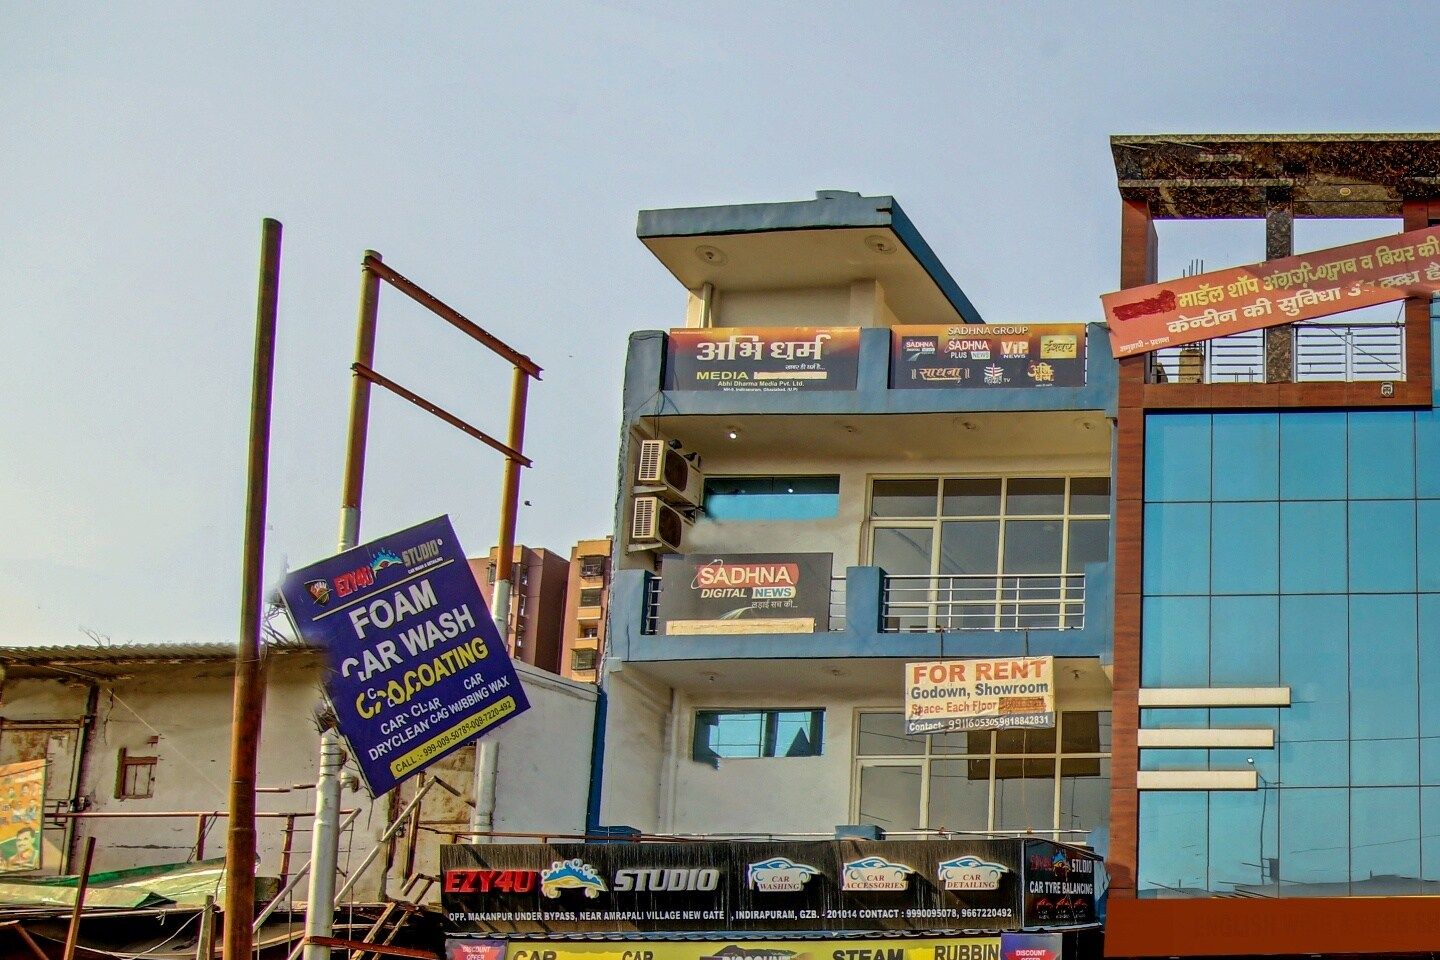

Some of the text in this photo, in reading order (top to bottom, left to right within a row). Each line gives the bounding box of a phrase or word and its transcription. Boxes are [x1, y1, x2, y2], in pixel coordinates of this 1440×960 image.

[1375, 245, 1415, 268] बियर
[1417, 235, 1440, 258] की
[1241, 298, 1273, 318] की
[948, 326, 1029, 336] SADHNA GROUP
[696, 334, 832, 361] अभि धर्म
[948, 341, 990, 351] SADHNA
[950, 351, 967, 359] PLUS
[972, 351, 990, 360] NEWS
[696, 371, 749, 380] MEDIA
[401, 539, 439, 568] STUDIO
[700, 566, 794, 586] SADHNA
[701, 588, 792, 599] DIGITAL NEWS
[349, 579, 438, 640] FOAM
[771, 600, 782, 608] सच
[399, 603, 476, 657] WASH
[913, 660, 1047, 685] FOR RENT
[463, 672, 485, 691] CAR
[488, 675, 510, 695] WAX
[911, 682, 1048, 700] Godown, Showroom
[946, 701, 970, 713] Each
[972, 700, 997, 714] Floor
[395, 755, 418, 773] CALL
[444, 868, 720, 894] EZY4U STUDIO
[771, 875, 790, 883] CAR
[867, 874, 885, 882] CAR
[947, 881, 995, 889] DETAILING
[759, 883, 800, 891] WASHING
[1029, 880, 1093, 895] CAR TYRE BALANCING
[449, 908, 1012, 923] OPP. MAKANPUR UNDER BYPASS, NEAR AMRAPALI VILLAGE NEW GATE INDIRAPURAM, GZB. 201014 CONTACT 9990095078, 9667220492
[466, 953, 485, 960] OFFER
